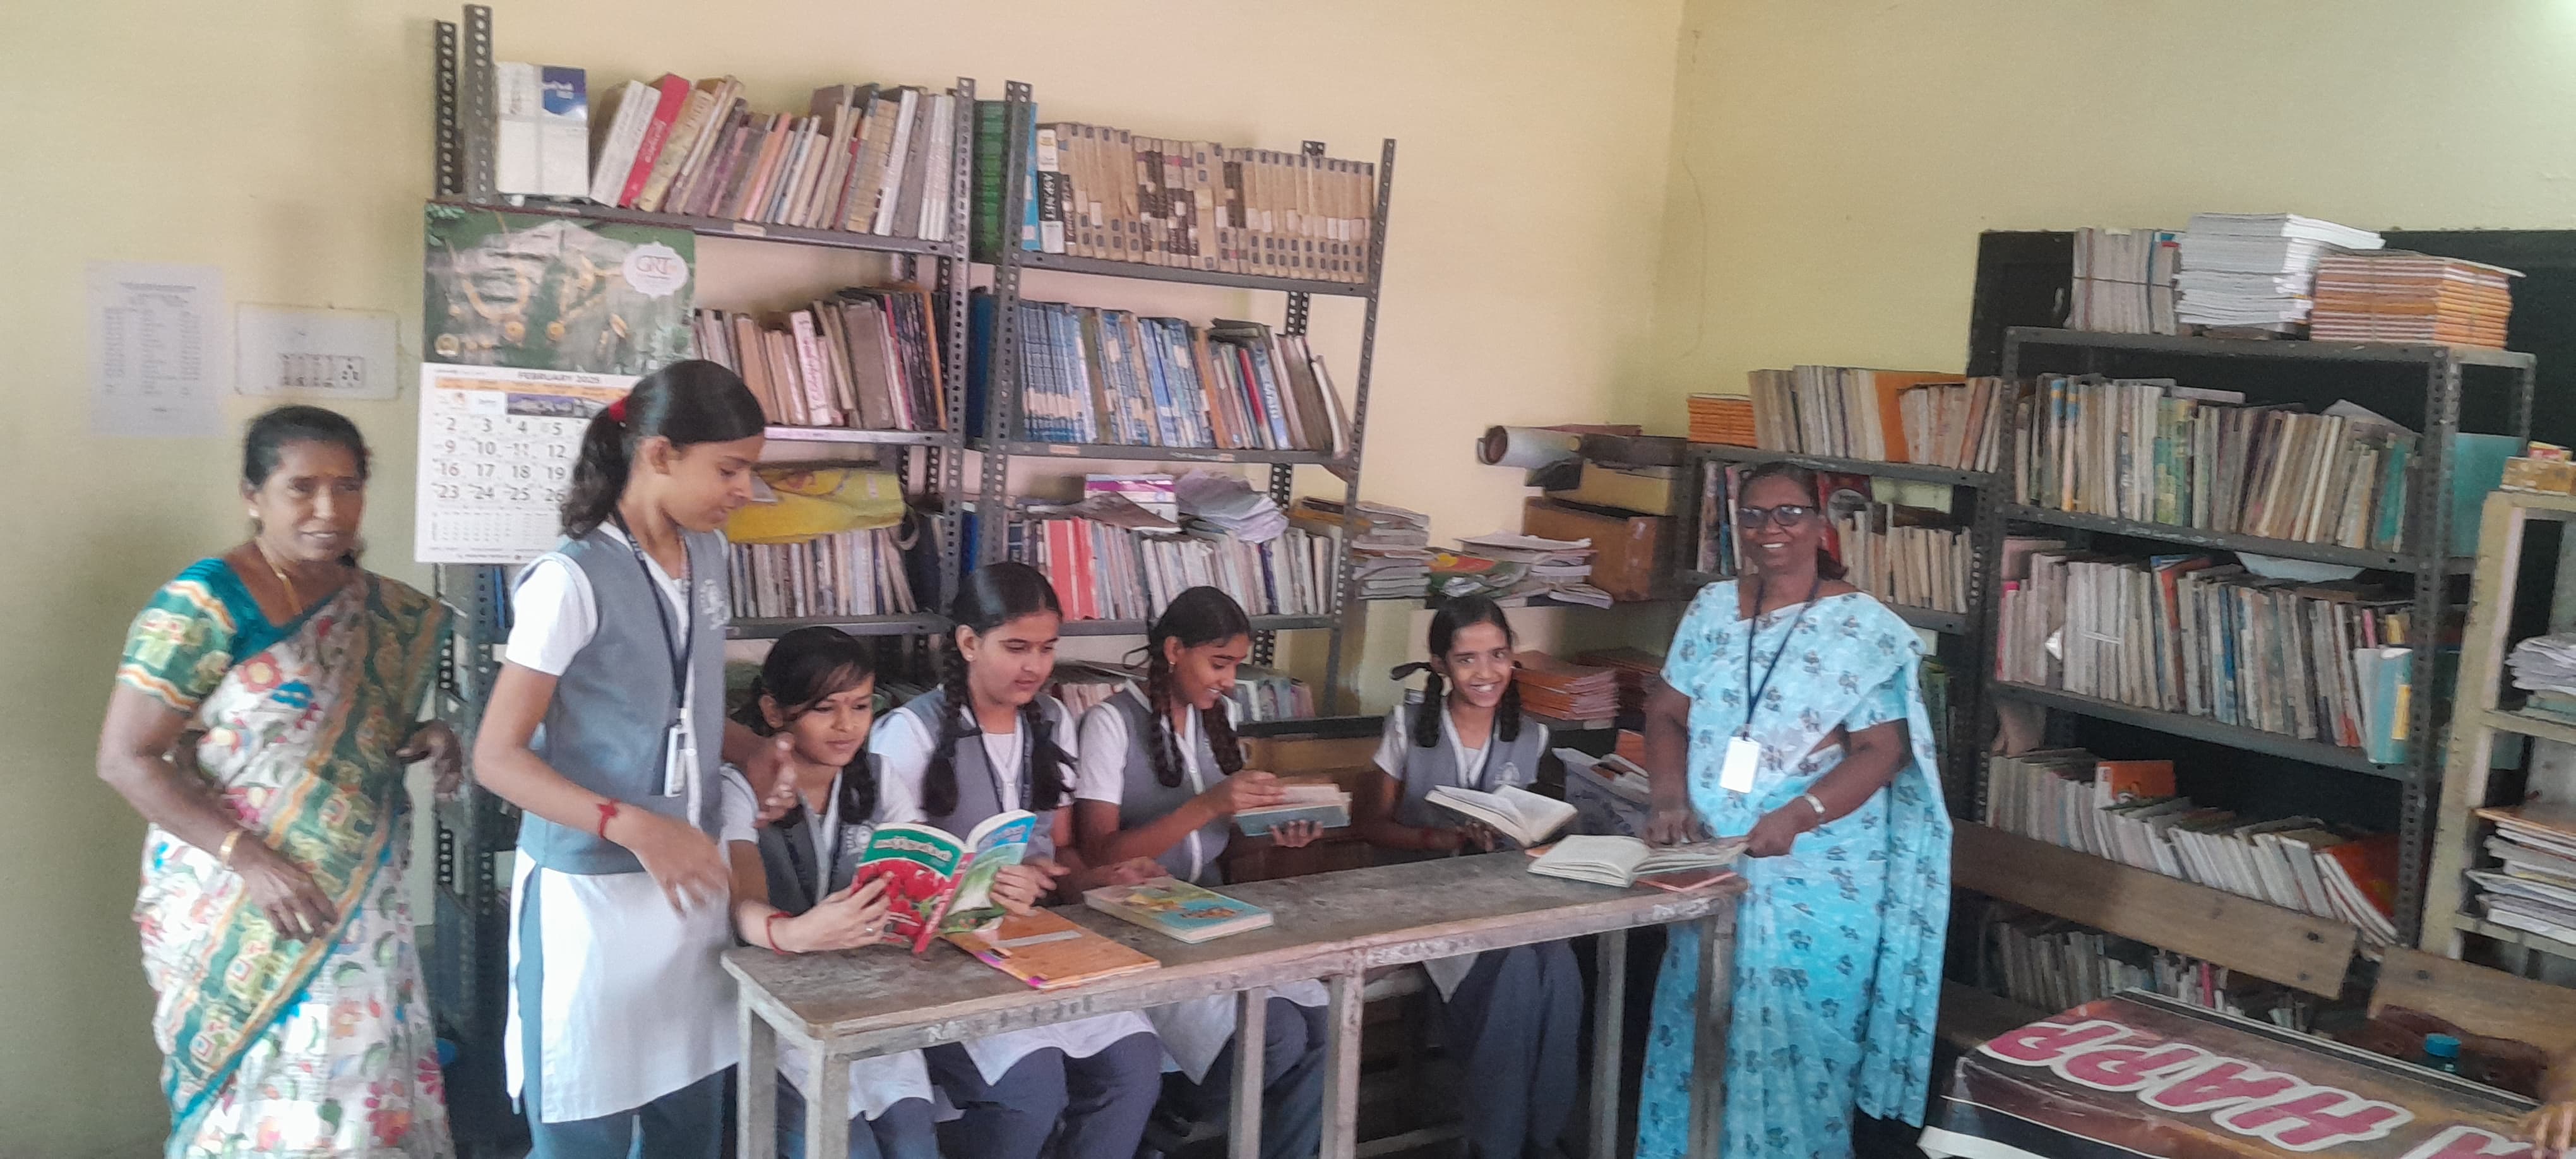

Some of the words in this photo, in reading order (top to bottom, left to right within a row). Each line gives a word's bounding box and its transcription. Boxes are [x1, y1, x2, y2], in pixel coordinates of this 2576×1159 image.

[1042, 172, 1056, 219] ASP.NET
[446, 417, 456, 431] 2
[482, 417, 492, 432] 3
[517, 420, 528, 434] 4
[552, 422, 563, 436] 5
[445, 439, 456, 453] 9
[477, 441, 497, 455] 10
[513, 443, 530, 456] 11
[547, 444, 567, 458] 12
[441, 462, 460, 477] 16
[476, 463, 496, 477] 17
[512, 465, 532, 479] 18
[547, 466, 566, 480] 19
[439, 484, 460, 499] 23
[474, 486, 496, 500] 24
[510, 487, 532, 501] 25
[545, 488, 566, 502] 26
